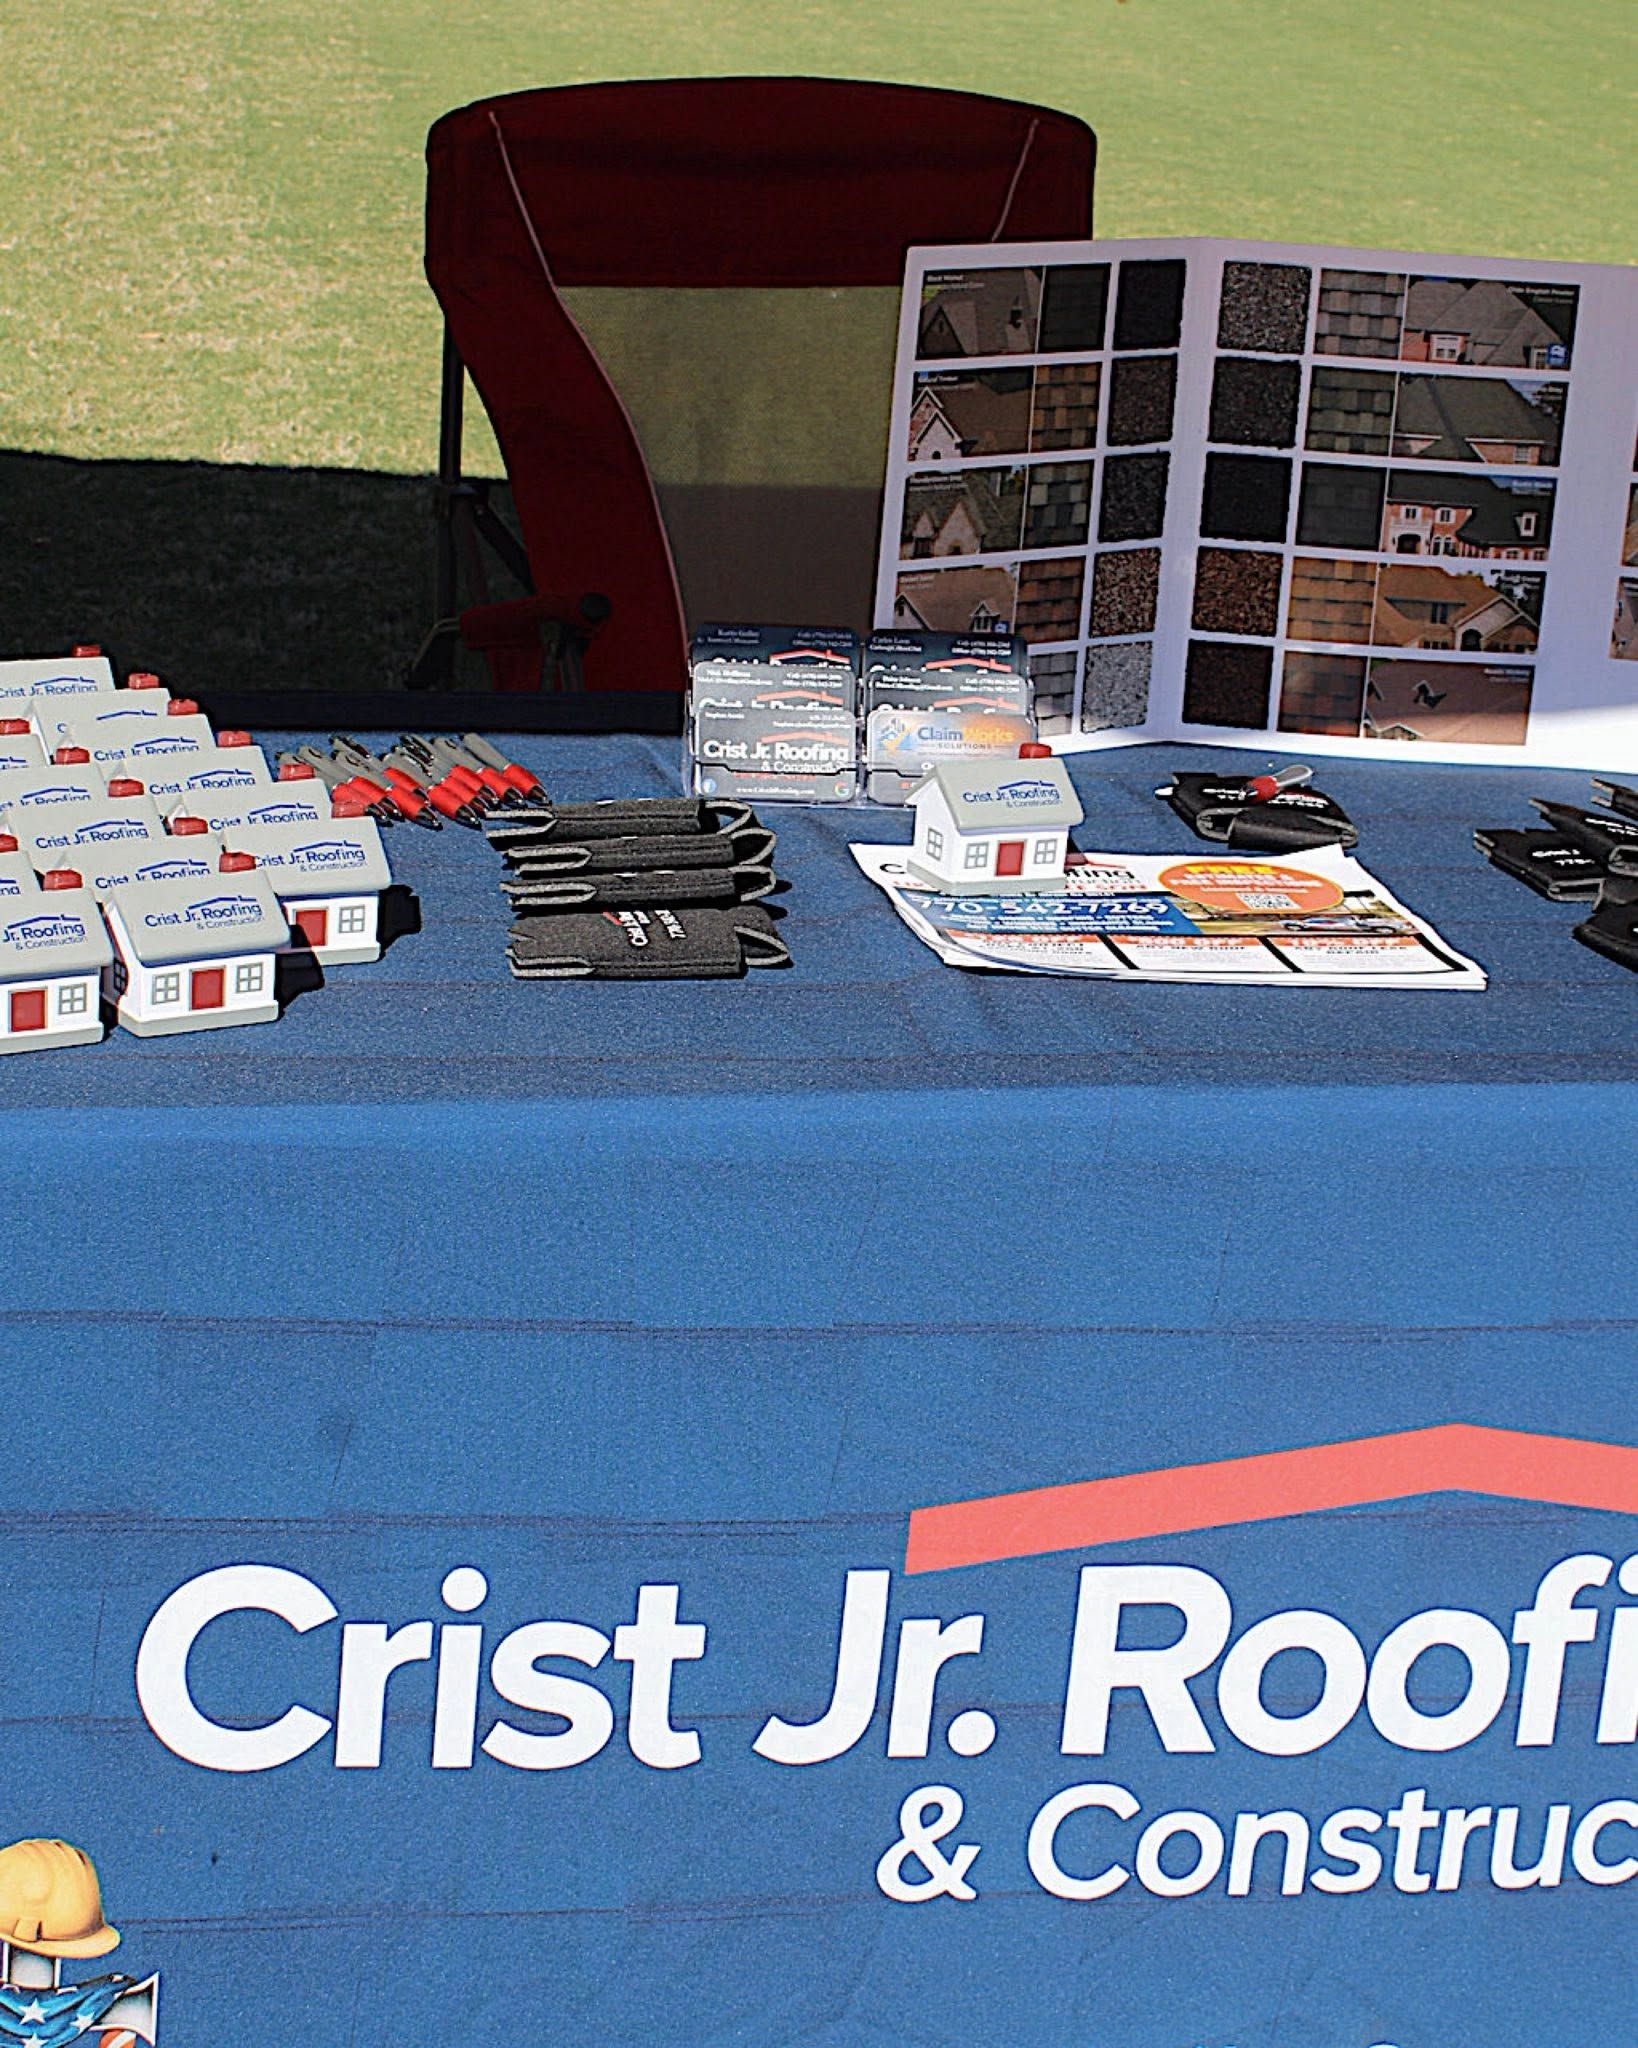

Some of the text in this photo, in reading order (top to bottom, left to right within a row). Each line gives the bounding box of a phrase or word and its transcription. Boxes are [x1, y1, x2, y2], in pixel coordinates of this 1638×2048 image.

[703, 740, 749, 759] Crist
[775, 742, 850, 762] Roofing
[149, 784, 182, 795] Crist
[1009, 787, 1060, 800] Roofing
[35, 836, 71, 849] Crist
[90, 828, 149, 842] Roofing
[305, 849, 366, 862] Roofing
[144, 914, 182, 928] Crist
[201, 903, 263, 920] Roofing
[205, 917, 265, 929] Construction
[20, 922, 86, 940] Roofing
[24, 936, 88, 950] Construction
[138, 1565, 705, 1770] Crist
[753, 1571, 995, 1763] Jr.
[877, 1785, 1638, 1901] & Construc
